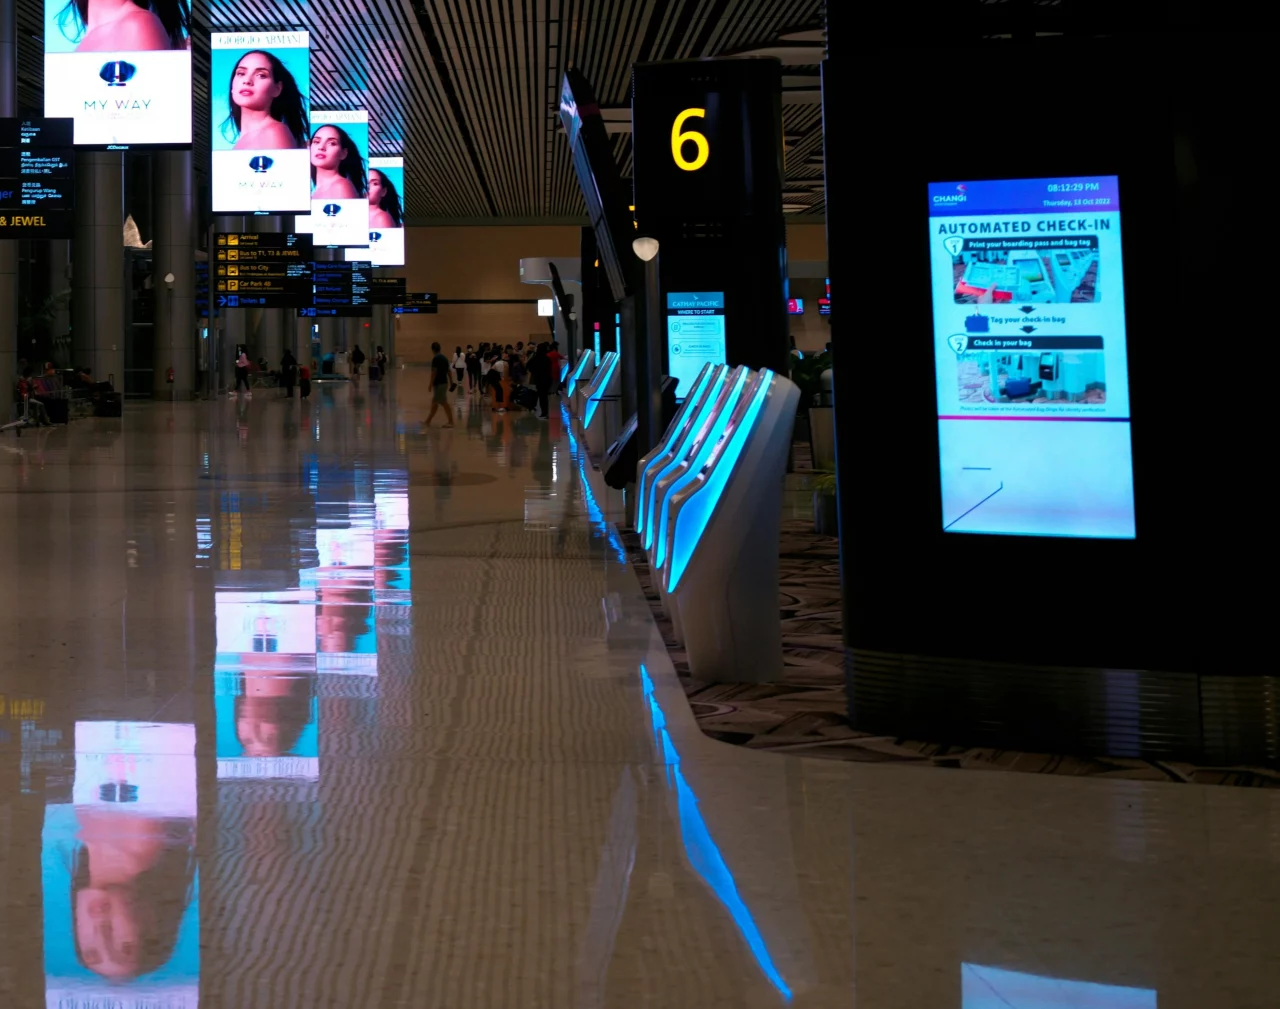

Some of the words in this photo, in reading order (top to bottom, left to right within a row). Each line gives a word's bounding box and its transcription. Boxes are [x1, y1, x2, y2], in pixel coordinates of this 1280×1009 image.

[84, 99, 107, 110] MY
[115, 99, 151, 110] WAY
[670, 108, 710, 172] 6
[1047, 184, 1083, 192] 08:12:29
[1085, 183, 1099, 191] PM
[933, 194, 967, 203] CHANGI
[1043, 199, 1072, 207] Thursday,
[0, 217, 7, 226] &
[9, 216, 46, 227] JEWEL
[938, 220, 1031, 235] AUTOMATED
[1036, 218, 1110, 232] CHECK-IN
[986, 241, 1001, 249] your
[1002, 239, 1033, 249] boarding
[1064, 239, 1077, 248] bag
[1078, 239, 1091, 247] tag
[952, 244, 957, 254] 1
[990, 316, 1003, 325] Tag
[1052, 316, 1066, 324] bag
[957, 342, 963, 351] 2
[1002, 340, 1017, 348] your
[1018, 339, 1032, 348] bag
